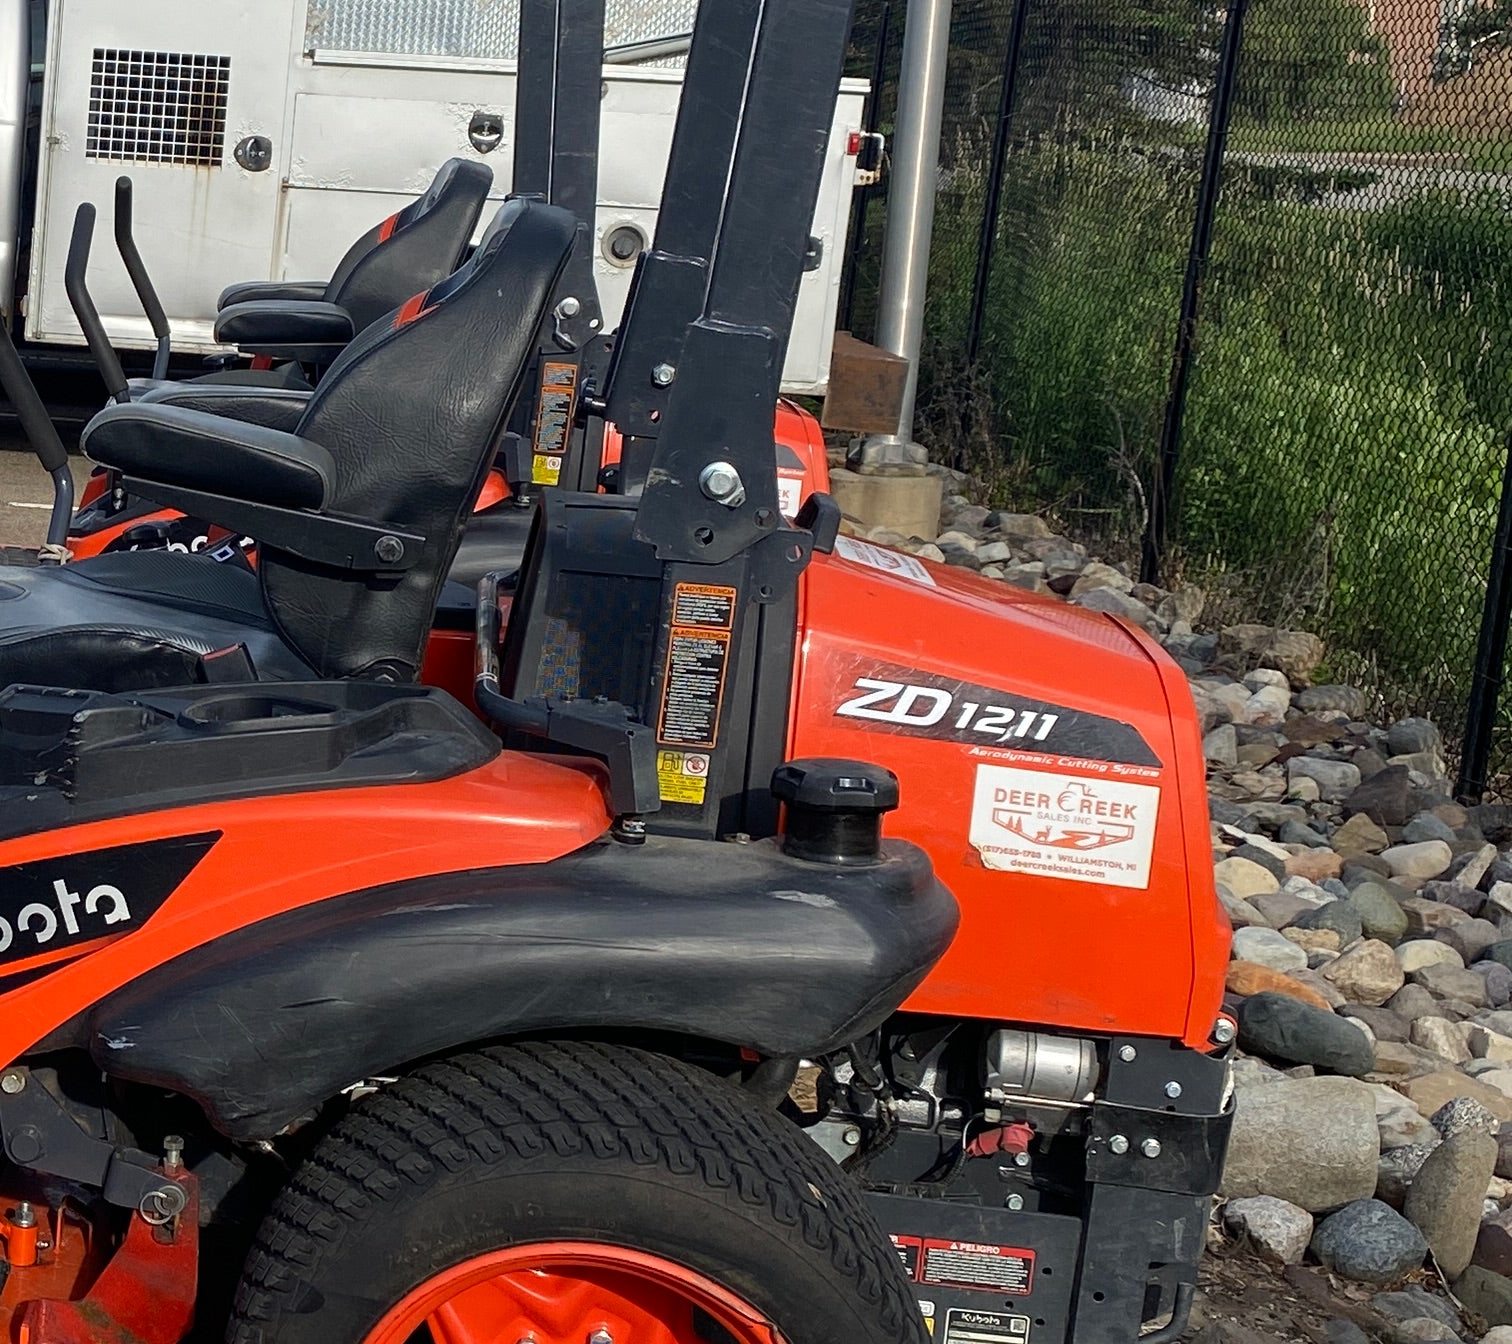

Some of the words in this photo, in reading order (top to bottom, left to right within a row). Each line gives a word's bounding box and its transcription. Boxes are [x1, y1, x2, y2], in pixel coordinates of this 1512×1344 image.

[837, 677, 952, 726] ZD
[955, 703, 1059, 741] 1211
[969, 747, 1054, 764] Aerodynamic
[1058, 758, 1108, 773] Cutting
[1112, 764, 1160, 777] System
[994, 788, 1050, 809] DEER
[1057, 791, 1138, 820] CREEK
[1037, 811, 1070, 823] SALES
[1074, 813, 1092, 825] INC
[1011, 859, 1105, 877] deercreeksales.com
[959, 1243, 1000, 1254] PELIGRO
[961, 1313, 1000, 1325] Kubota
